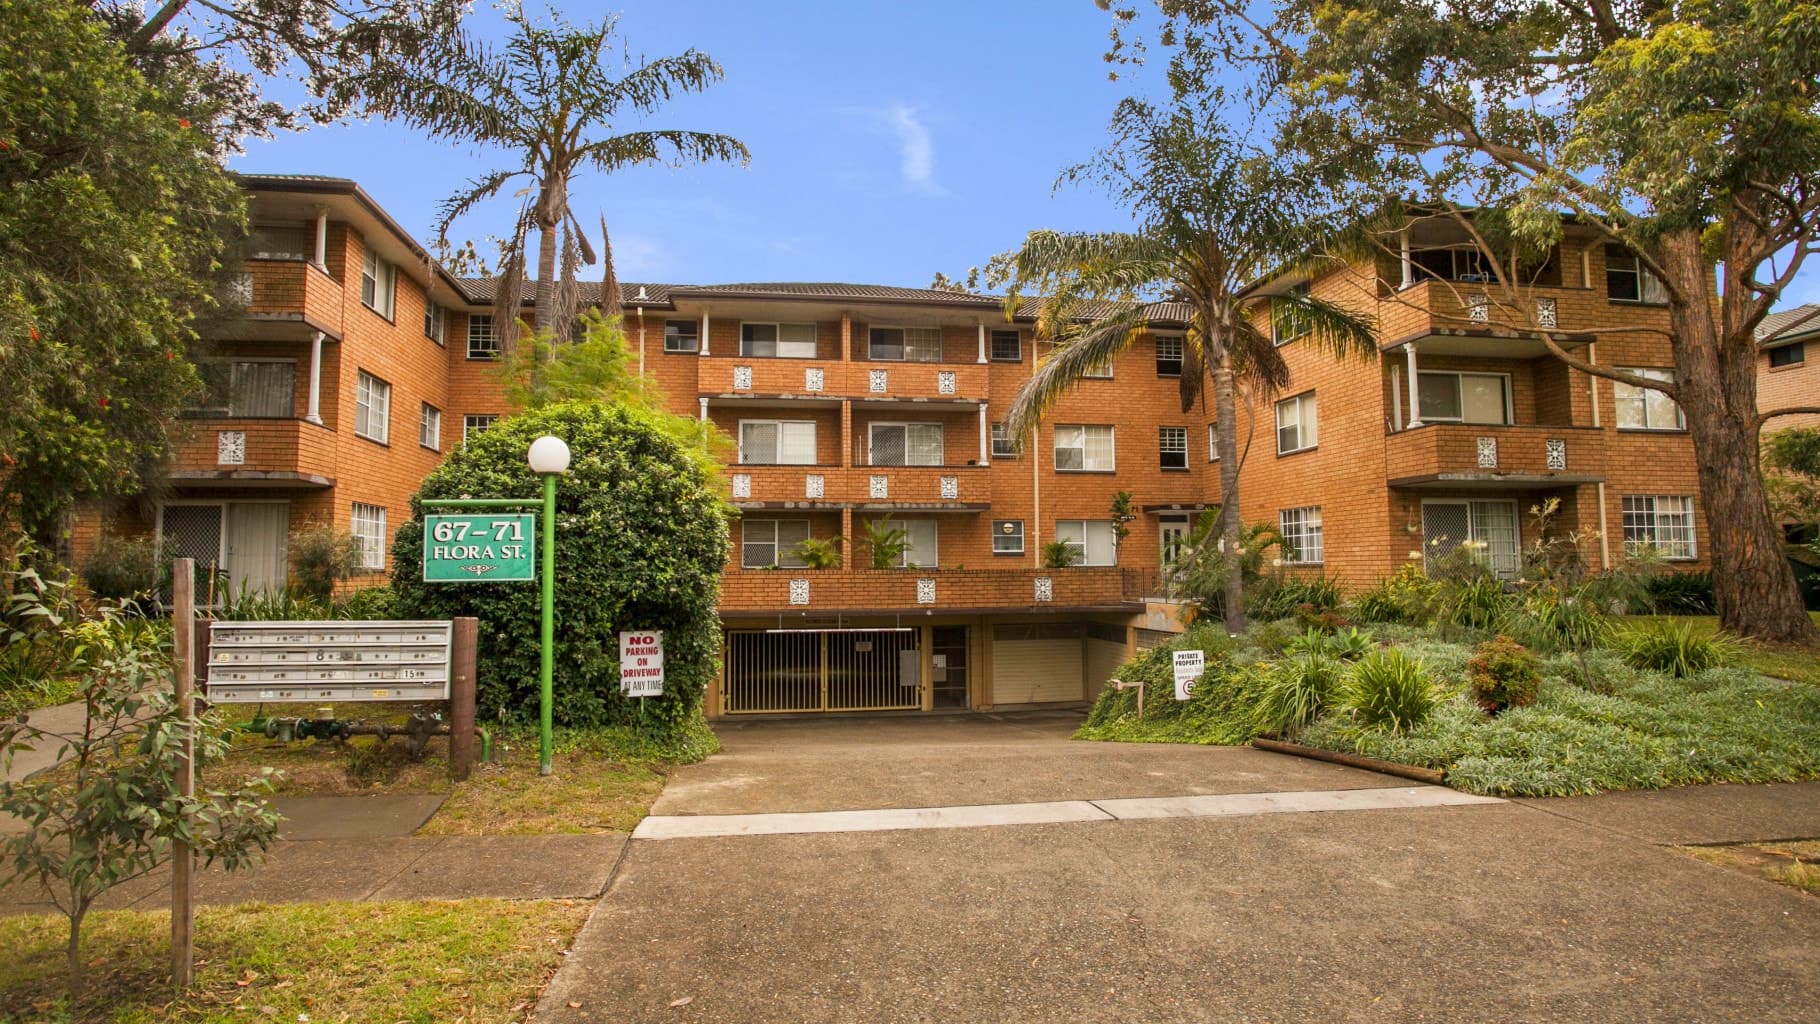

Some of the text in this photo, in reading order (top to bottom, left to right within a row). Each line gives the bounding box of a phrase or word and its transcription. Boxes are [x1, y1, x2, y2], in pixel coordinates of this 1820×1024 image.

[433, 544, 526, 560] FLORA ST.
[629, 636, 655, 645] NO
[316, 649, 324, 661] 8
[625, 647, 659, 656] PARKING
[637, 658, 648, 666] ON
[404, 670, 415, 678] 15
[623, 668, 661, 678] DRIVEWAY
[624, 680, 662, 691] AT ANY TIME
